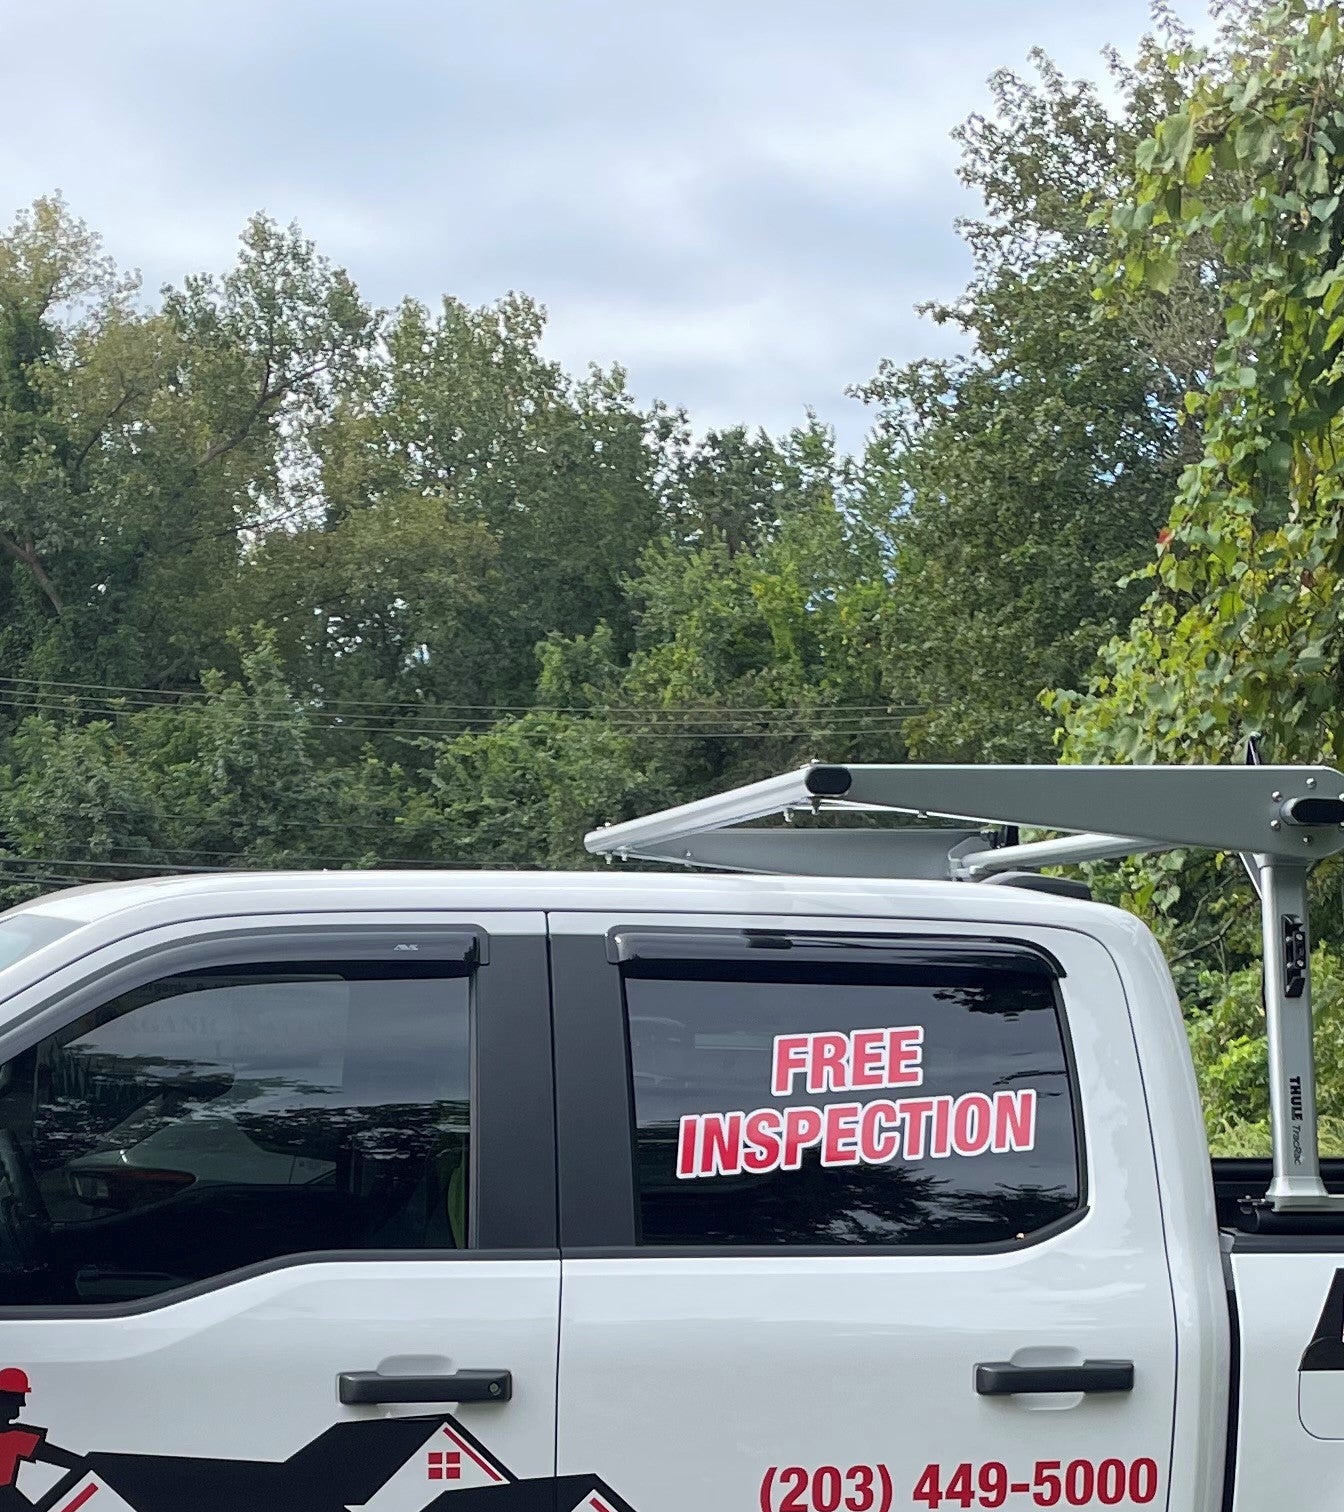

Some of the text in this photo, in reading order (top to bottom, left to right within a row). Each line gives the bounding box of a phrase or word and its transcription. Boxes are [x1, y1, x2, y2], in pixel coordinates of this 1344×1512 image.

[771, 1026, 924, 1096] FREE
[1289, 1075, 1304, 1121] THULE
[676, 1089, 1037, 1179] INSPECTION
[913, 1458, 1158, 1509] 449-5000
